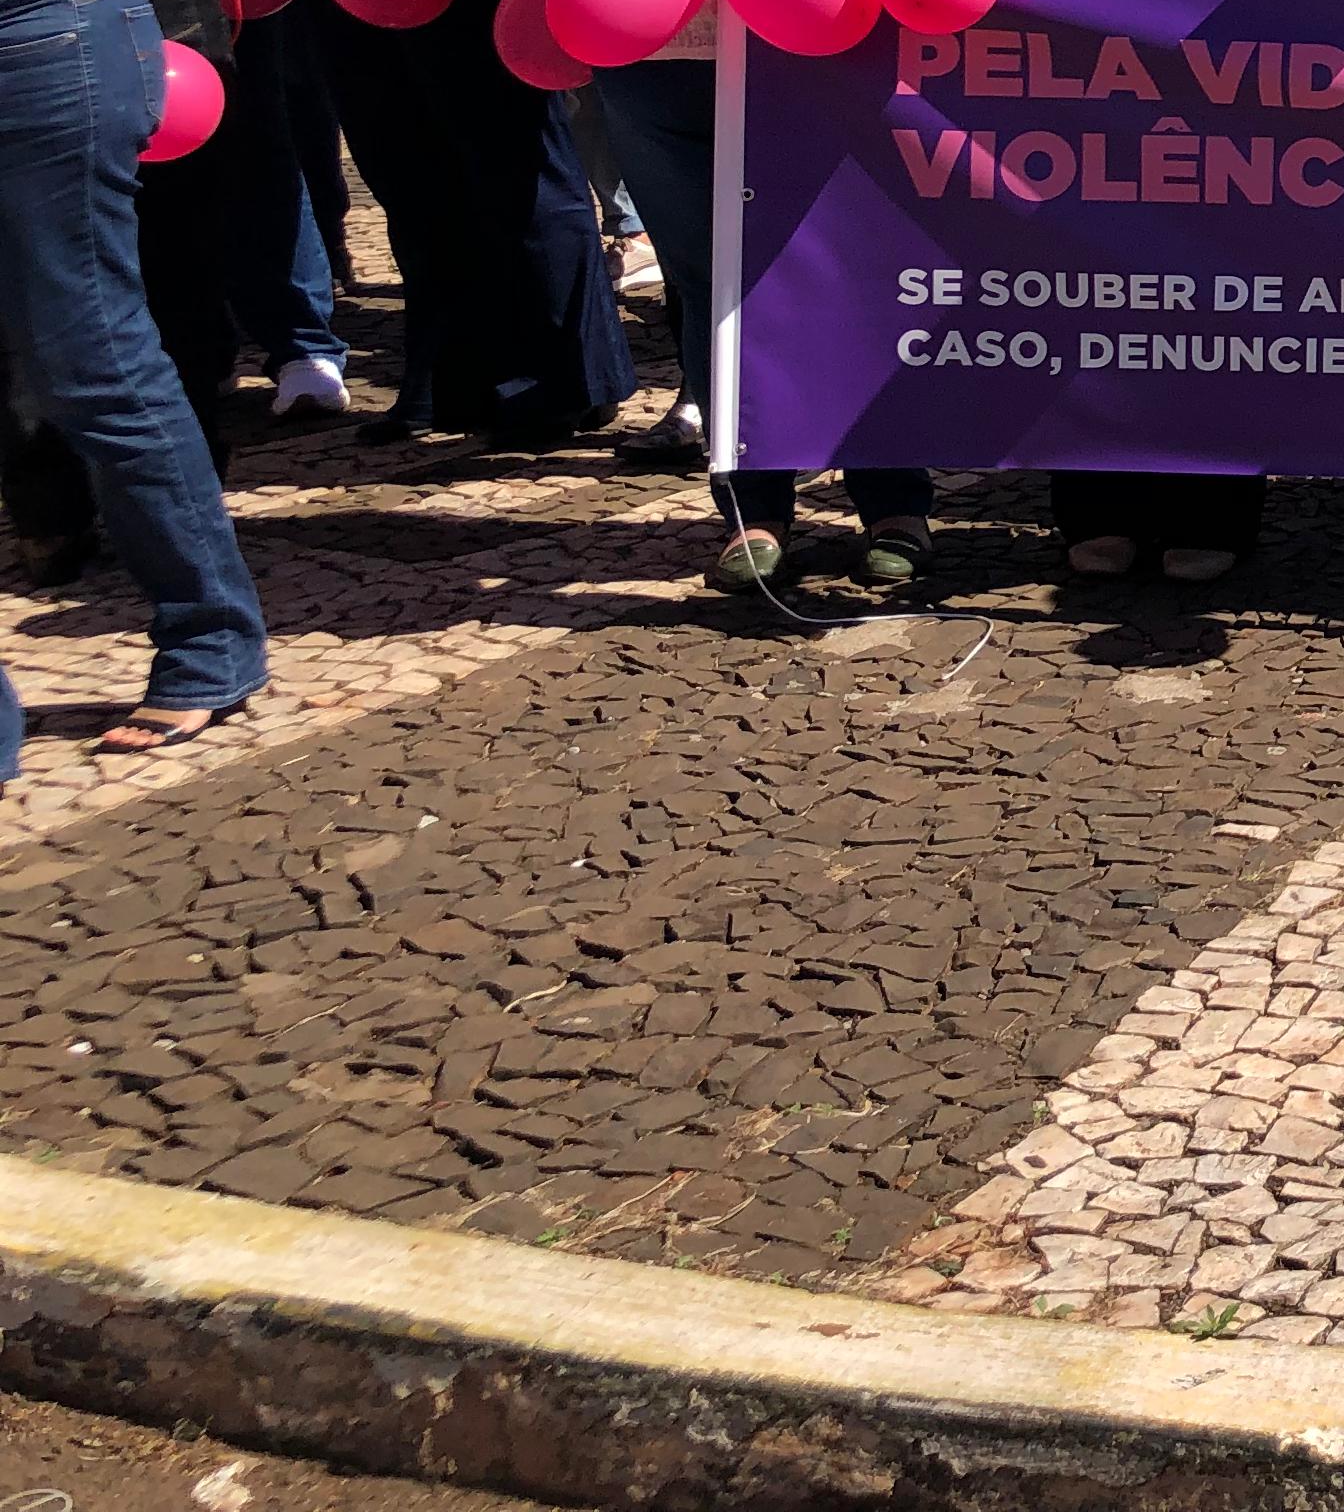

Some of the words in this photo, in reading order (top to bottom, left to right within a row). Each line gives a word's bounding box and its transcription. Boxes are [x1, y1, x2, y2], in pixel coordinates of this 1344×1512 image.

[896, 28, 1162, 100] PELA
[897, 268, 963, 306] SE
[979, 270, 1198, 312] SOUBER
[1211, 276, 1283, 314] DE
[897, 329, 1063, 376] CASO,
